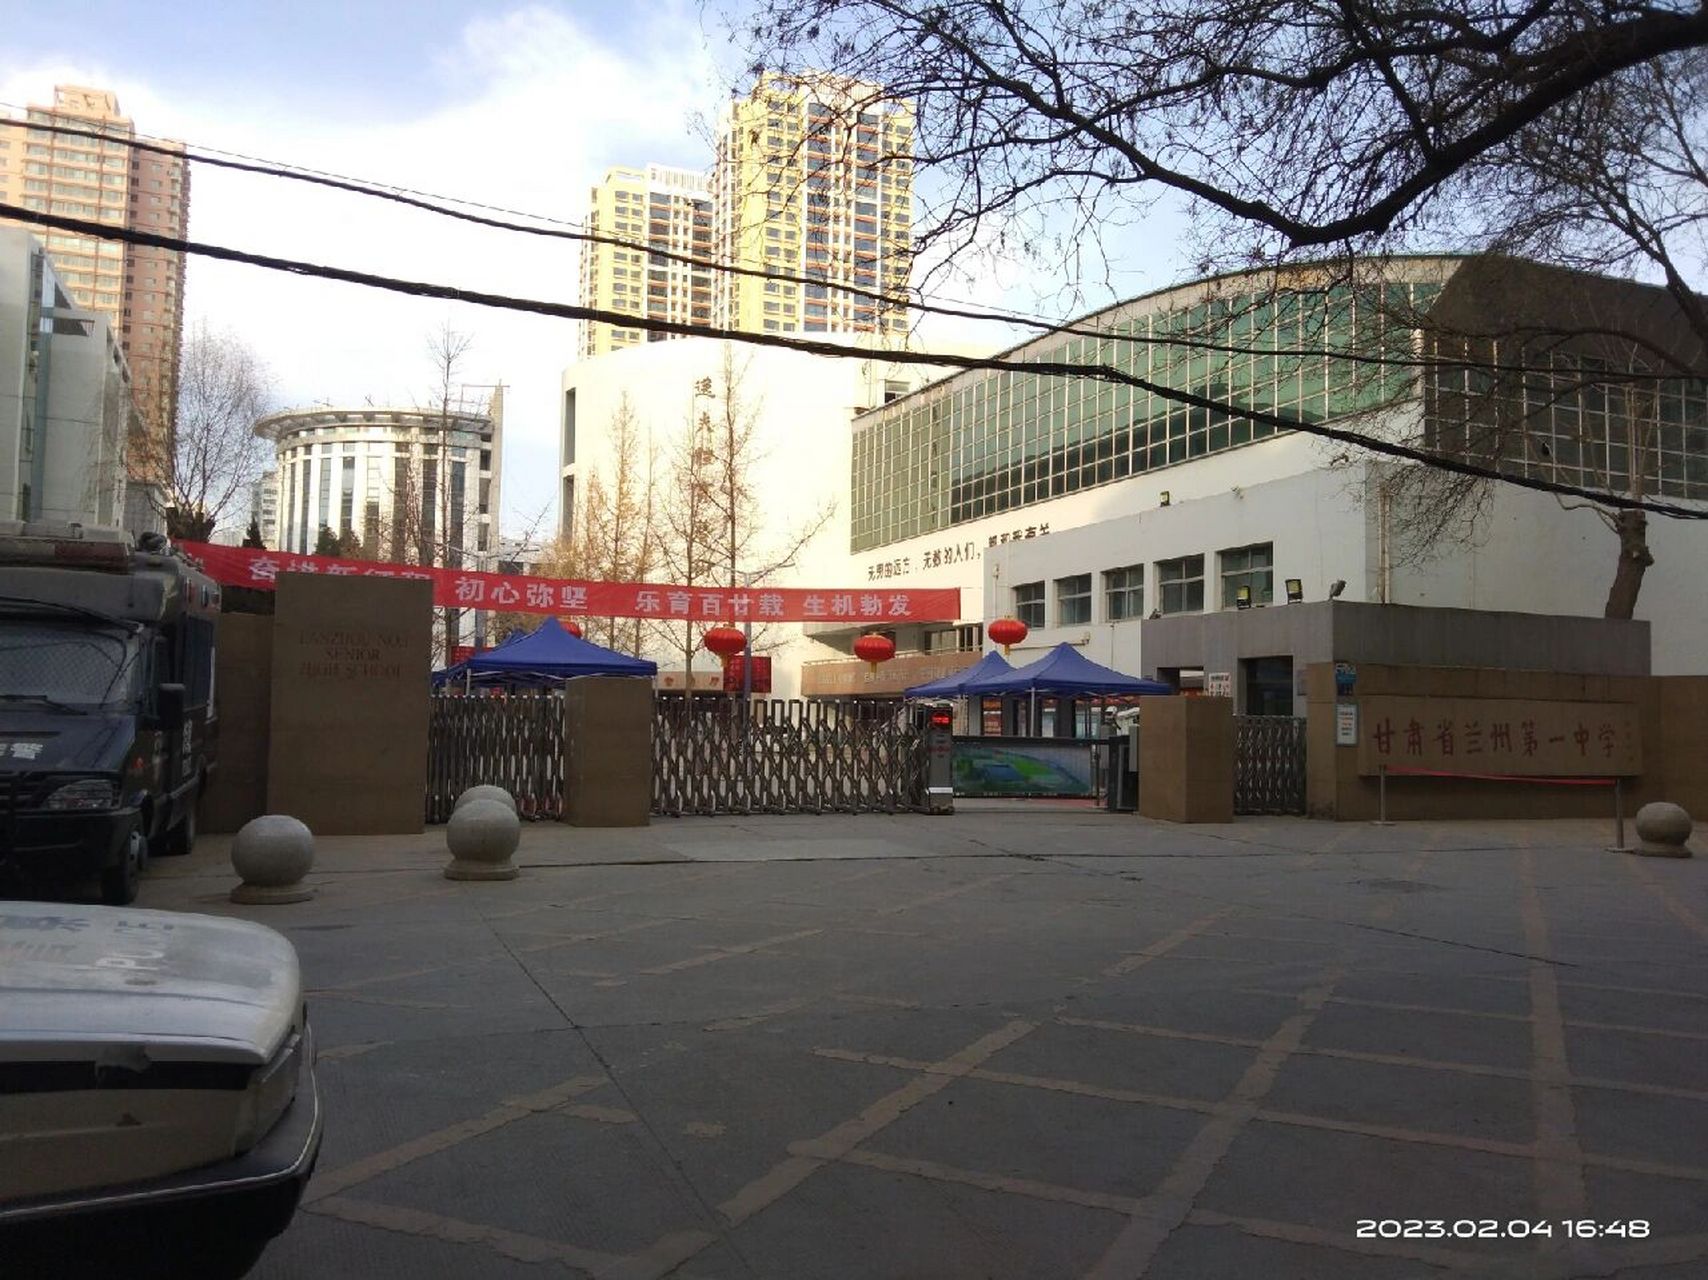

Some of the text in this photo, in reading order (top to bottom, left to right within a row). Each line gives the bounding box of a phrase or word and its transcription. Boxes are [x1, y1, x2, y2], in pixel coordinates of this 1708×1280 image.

[455, 576, 912, 618] 初心弥坚 乐育百廿载 生机勃发
[1373, 715, 1617, 759] 甘肃省兰州第一中学
